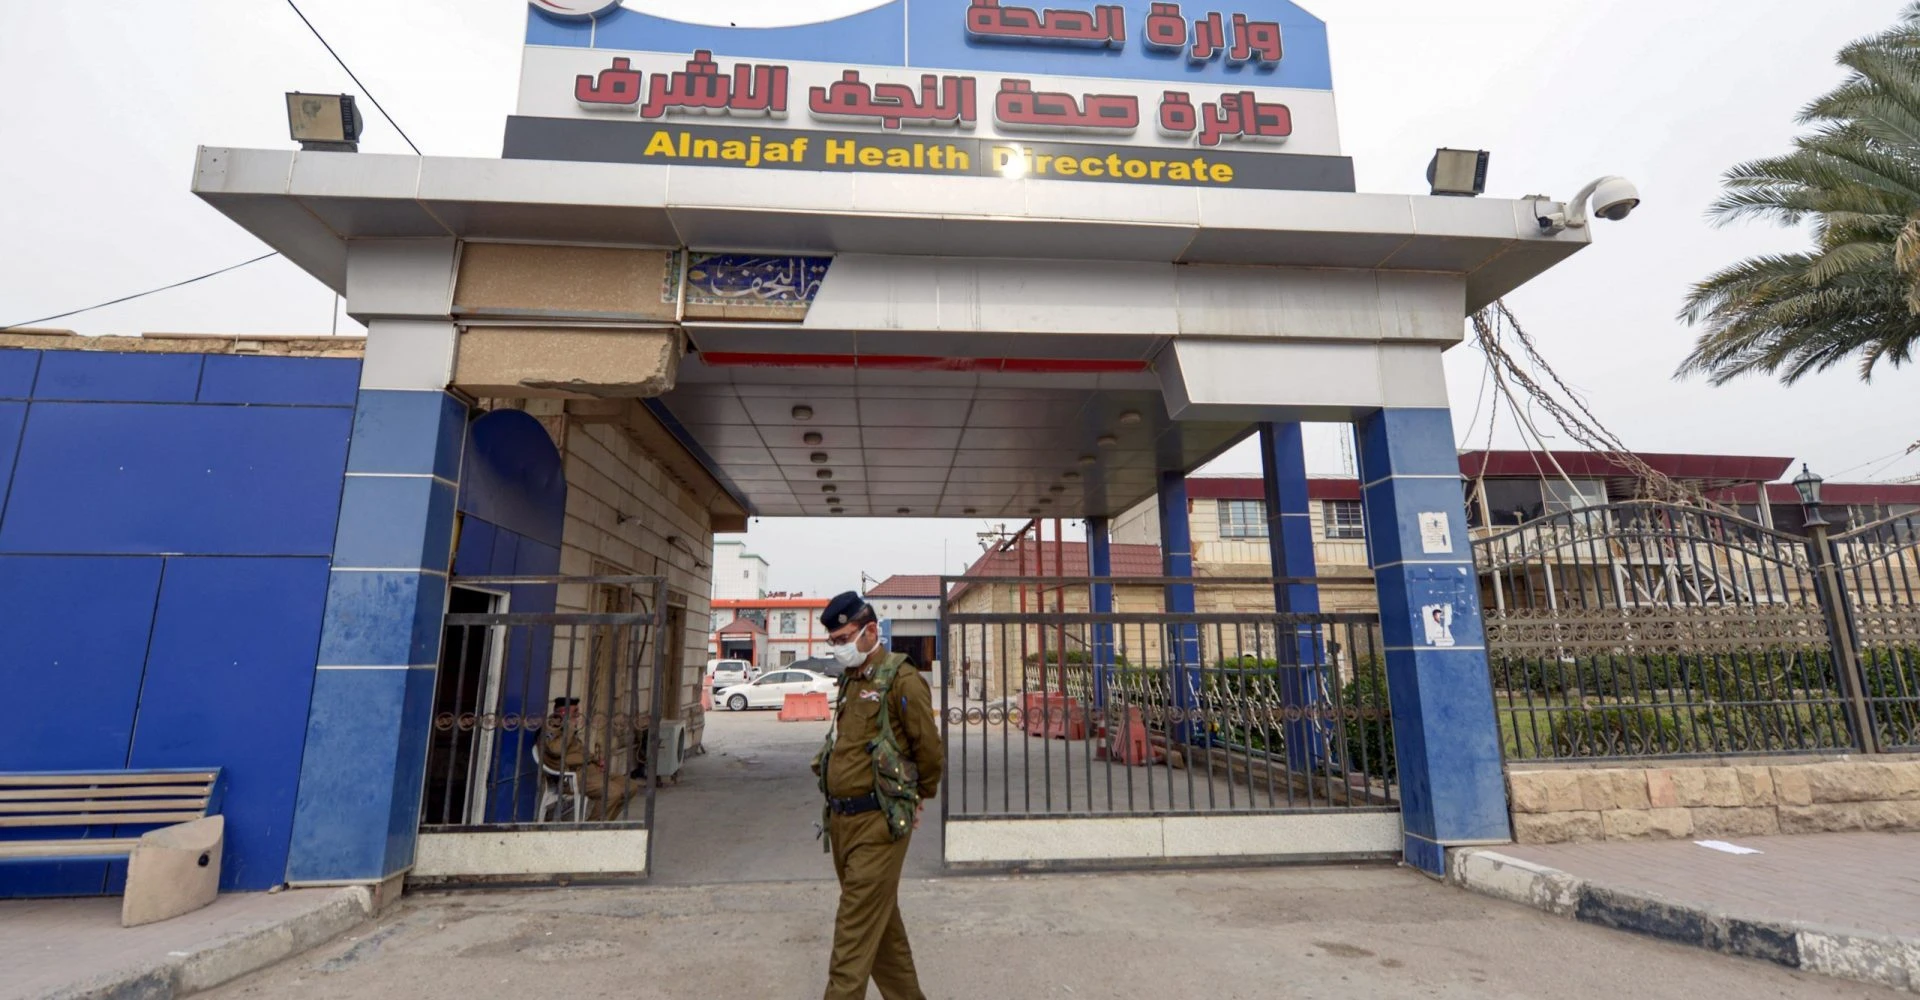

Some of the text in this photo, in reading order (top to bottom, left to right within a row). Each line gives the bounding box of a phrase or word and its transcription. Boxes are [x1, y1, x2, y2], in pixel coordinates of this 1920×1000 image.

[966, 0, 1283, 61] وزارة الصحة
[574, 49, 1293, 146] دائرة صحة النجف الاشرف
[643, 131, 1234, 183] Alnajaf Health Directorate
